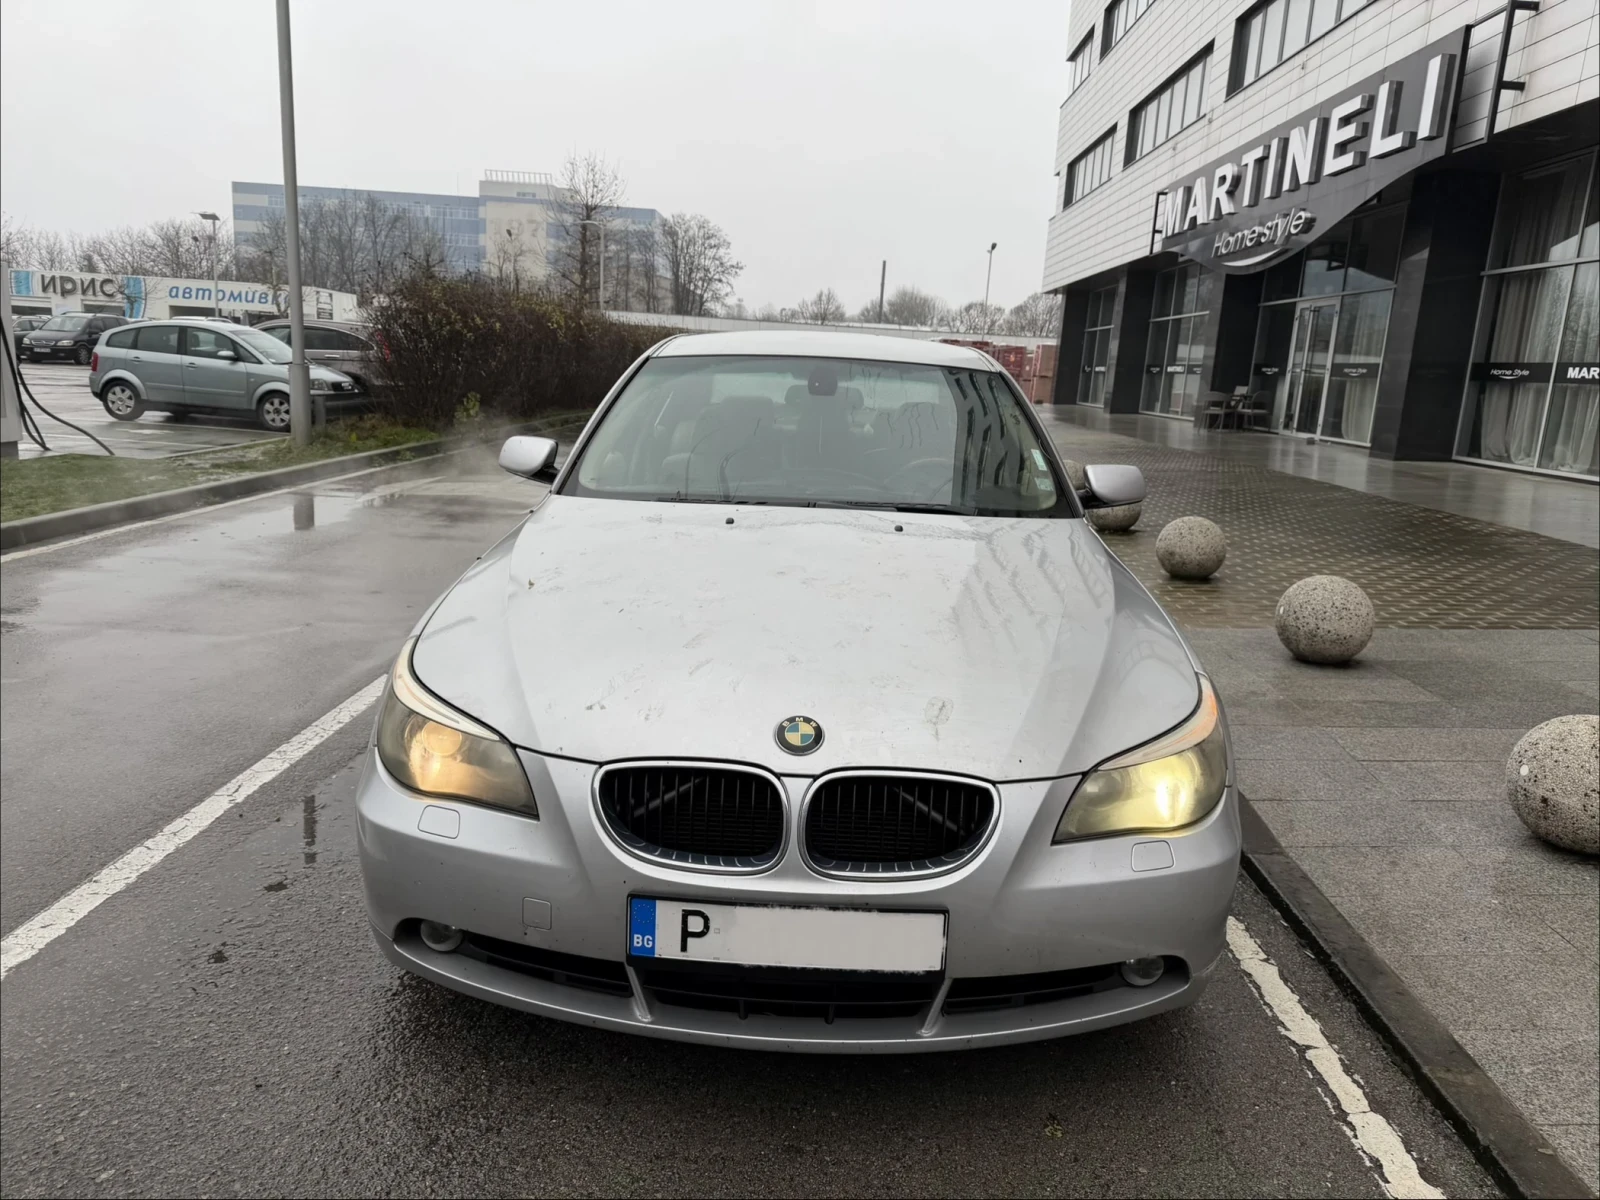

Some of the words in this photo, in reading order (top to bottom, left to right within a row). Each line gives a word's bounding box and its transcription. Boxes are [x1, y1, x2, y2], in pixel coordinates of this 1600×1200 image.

[1162, 53, 1455, 239] MARTINELI
[1211, 226, 1262, 258] Home
[1490, 368, 1512, 376] Home
[1512, 368, 1530, 377] Style
[781, 716, 818, 728] BMW
[633, 934, 654, 949] BG
[680, 908, 711, 953] P
